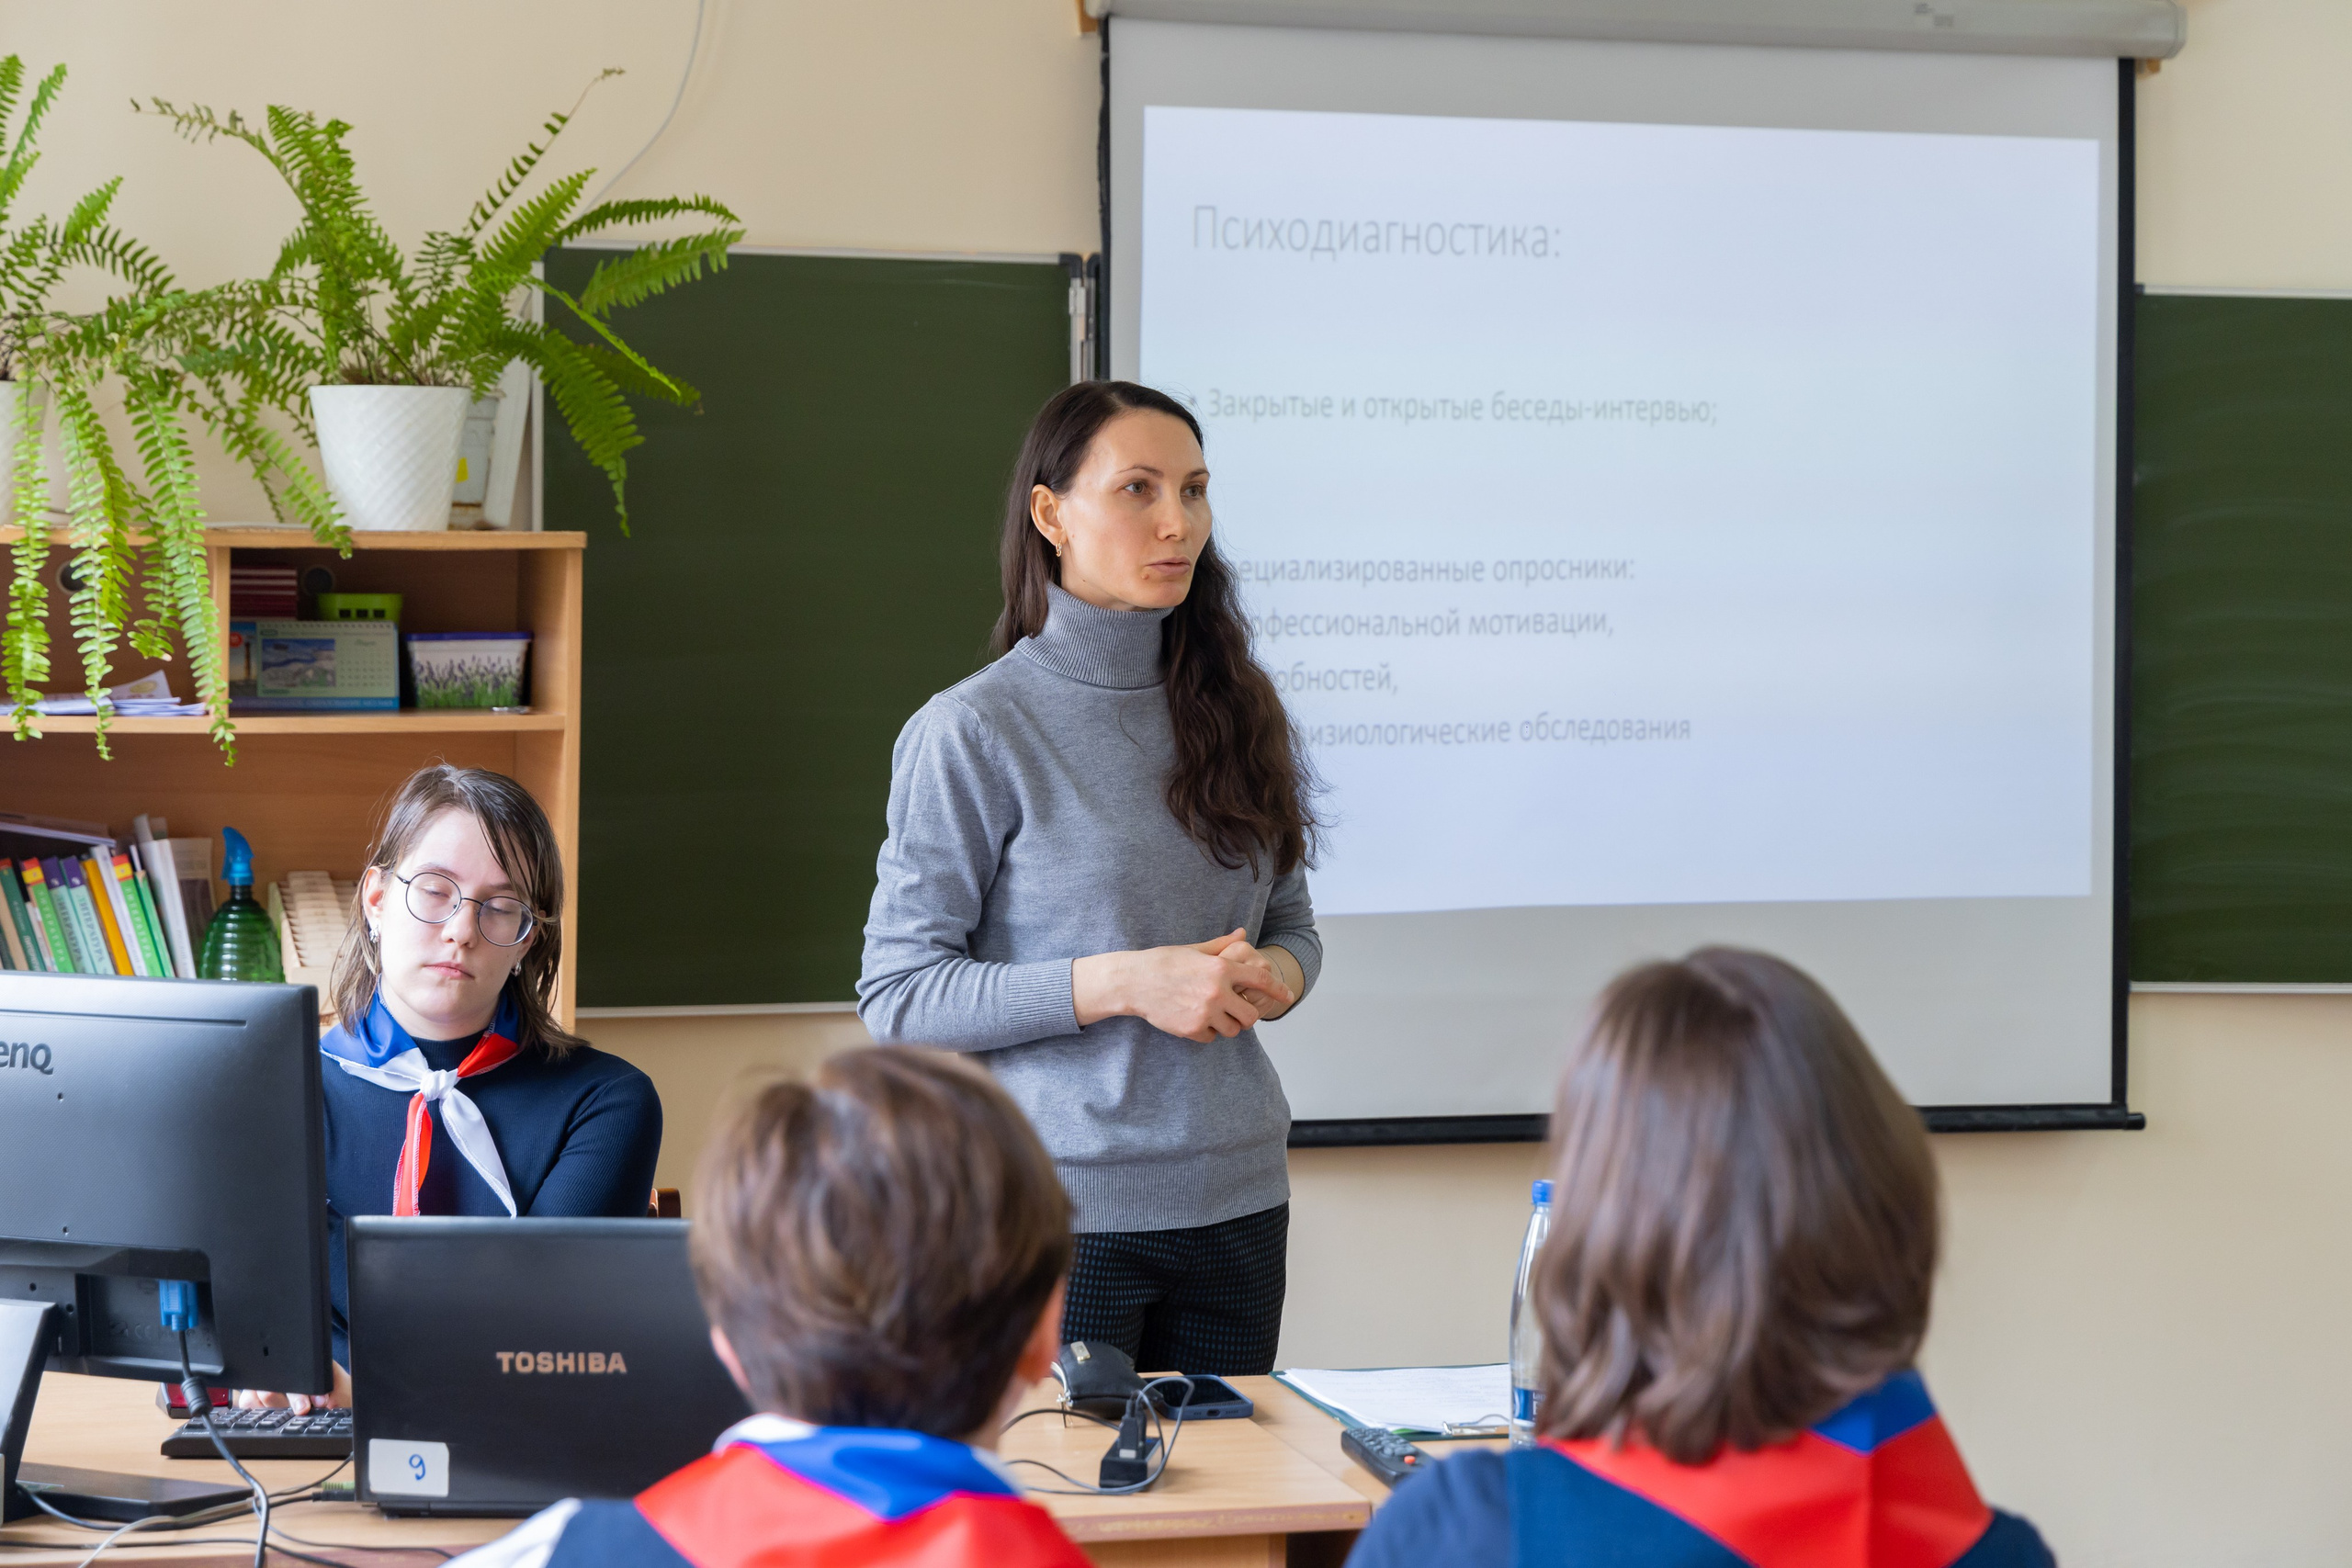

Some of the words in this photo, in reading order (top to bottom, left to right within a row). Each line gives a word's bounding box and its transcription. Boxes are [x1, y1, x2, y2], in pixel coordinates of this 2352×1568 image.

[1193, 204, 1562, 263] Психодиагностика:
[1207, 387, 1334, 423] Закрытые
[1341, 396, 1356, 419] и
[1363, 395, 1484, 426] открытые
[1490, 389, 1718, 428] беседы-интервью;
[1238, 558, 1486, 588] ециализированные
[1492, 558, 1635, 588] опросники:
[1468, 612, 1614, 638] мотивации,
[1276, 660, 1399, 695] обностей,
[1308, 721, 1512, 747] изиологические
[1518, 710, 1692, 747] обследования
[0, 1040, 54, 1076] enQ
[495, 1351, 628, 1374] TOSHIBA
[408, 1453, 426, 1481] 9
